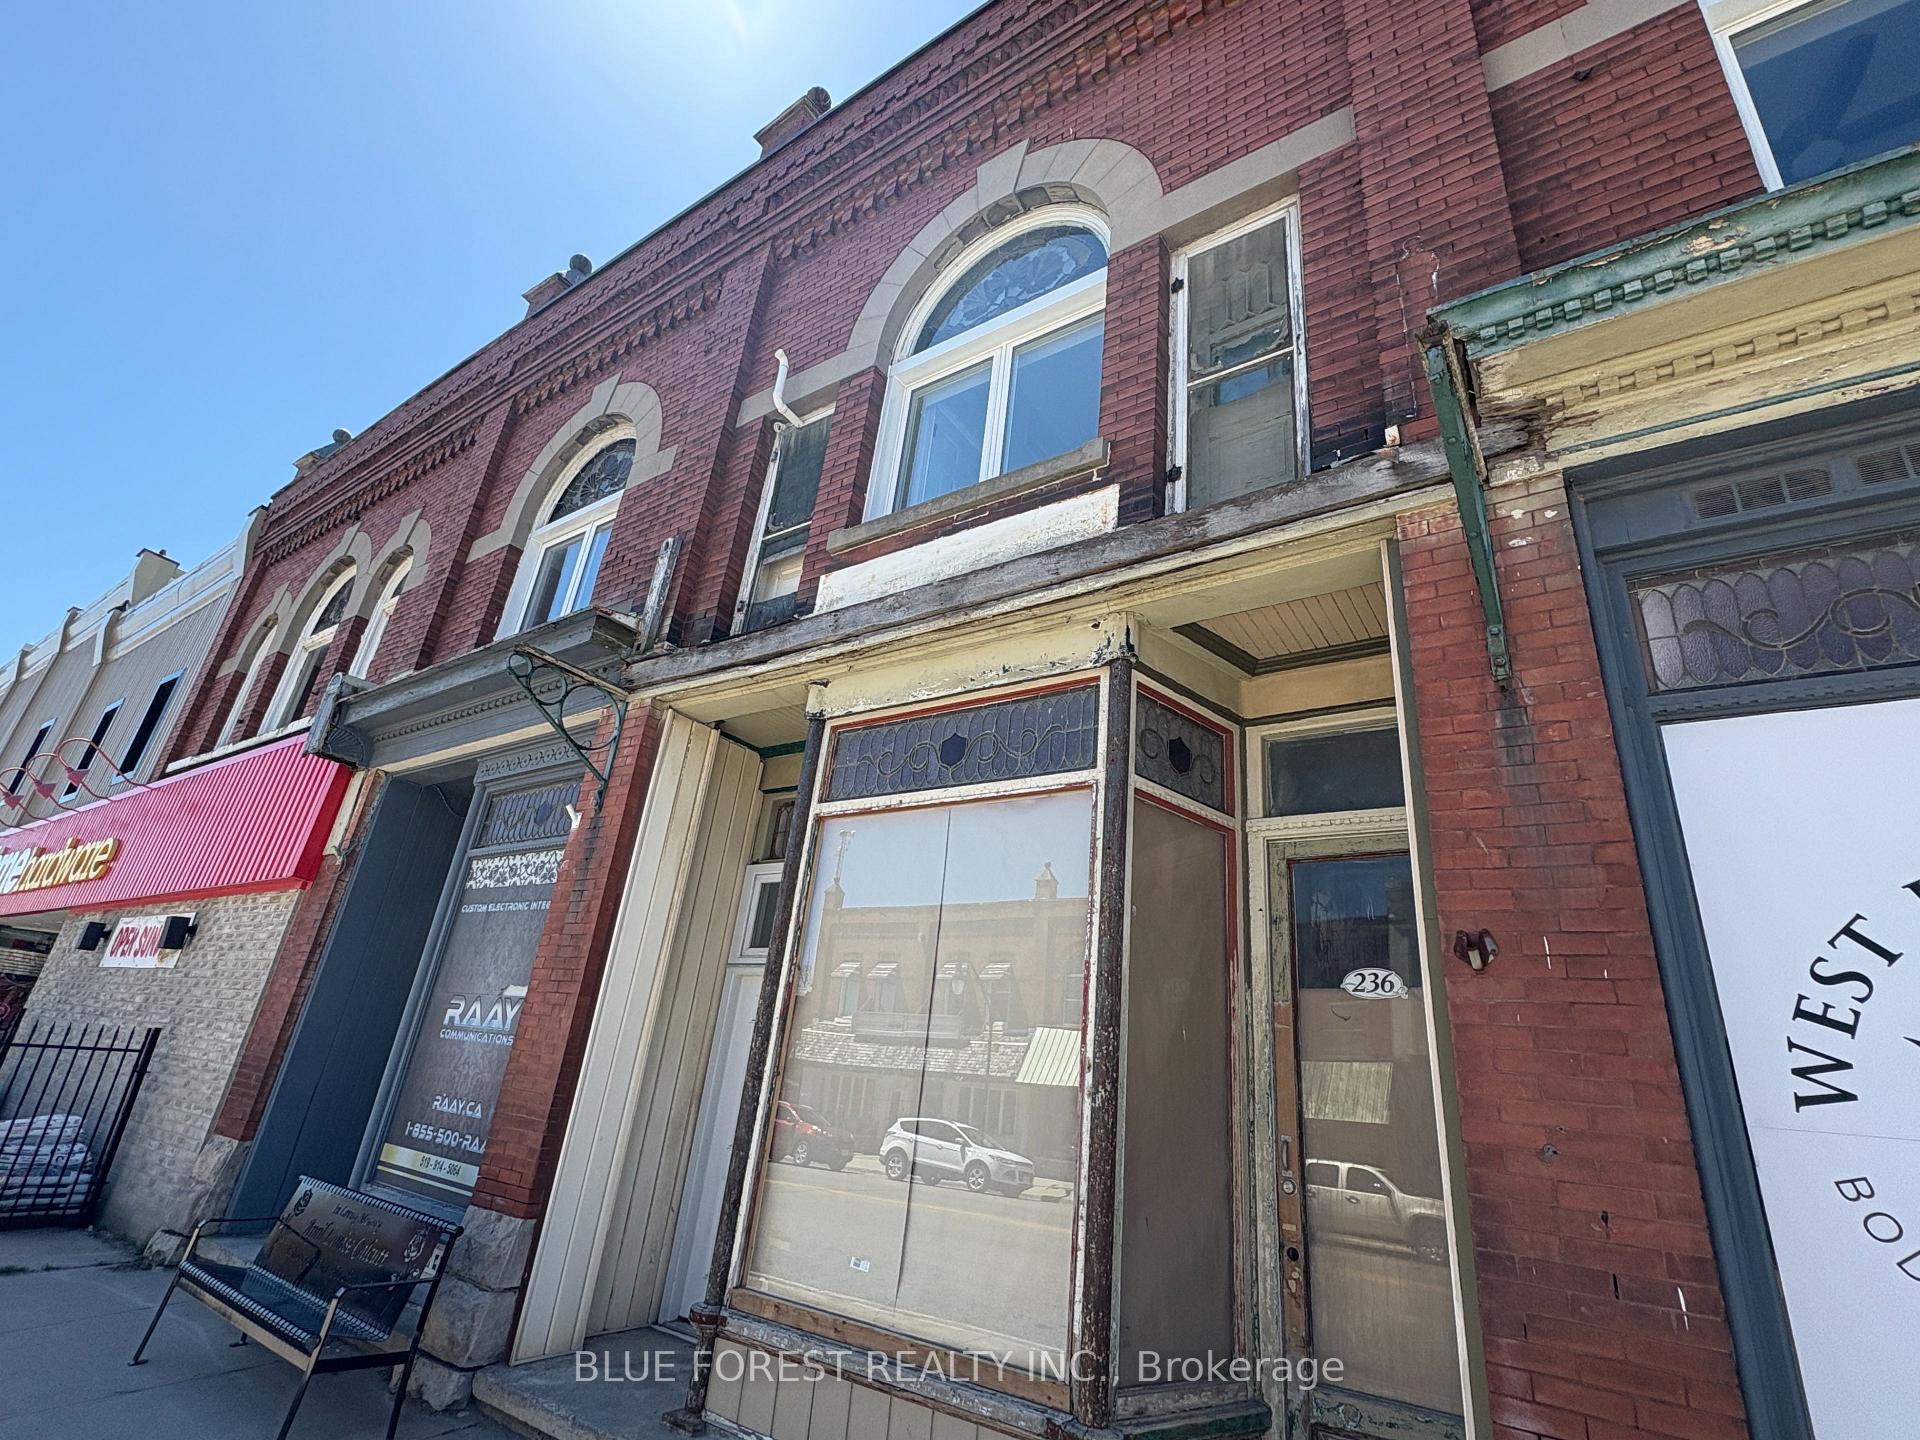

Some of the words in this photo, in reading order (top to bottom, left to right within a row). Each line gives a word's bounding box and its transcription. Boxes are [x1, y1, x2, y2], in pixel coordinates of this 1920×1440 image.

[462, 904, 488, 913] CUSTOM
[488, 901, 530, 912] ELECTRONIC
[109, 926, 140, 958] OPEN
[1351, 972, 1395, 993] 236
[443, 995, 525, 1031] RAAY
[1786, 913, 1904, 1114] WEST
[440, 1029, 514, 1045] COMMUNICATIONS
[432, 1095, 482, 1119] RAAY.CA
